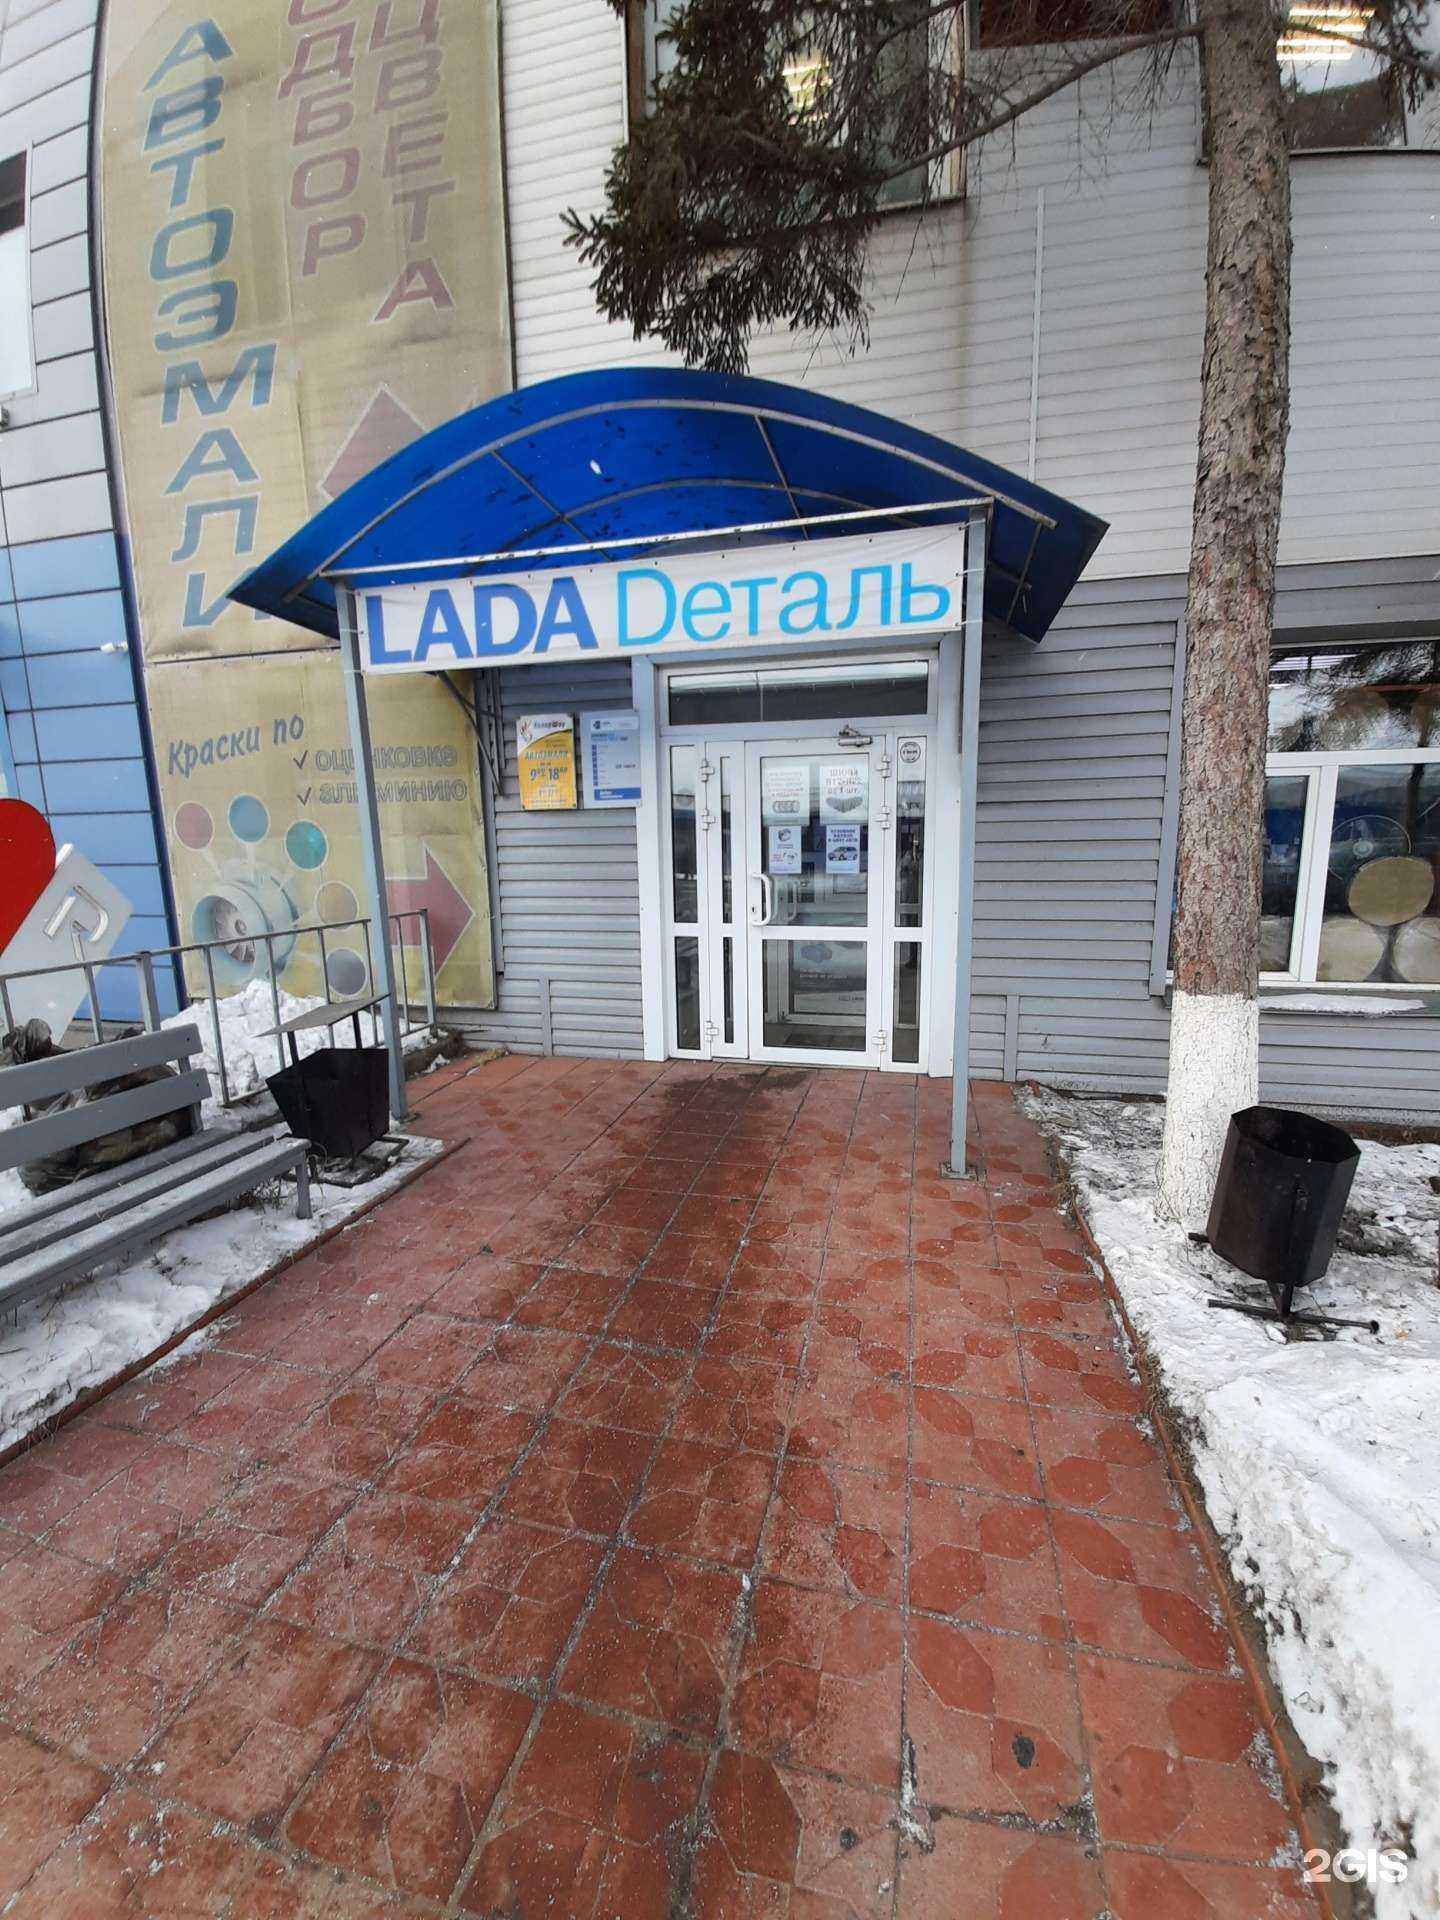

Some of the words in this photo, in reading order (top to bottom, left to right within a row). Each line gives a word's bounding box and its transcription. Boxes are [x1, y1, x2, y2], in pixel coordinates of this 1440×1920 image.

[368, 0, 456, 324] ЦВЕТА
[365, 576, 599, 666] LADA
[168, 727, 260, 777] Краски
[273, 714, 305, 746] по
[315, 744, 458, 775] оцнковке
